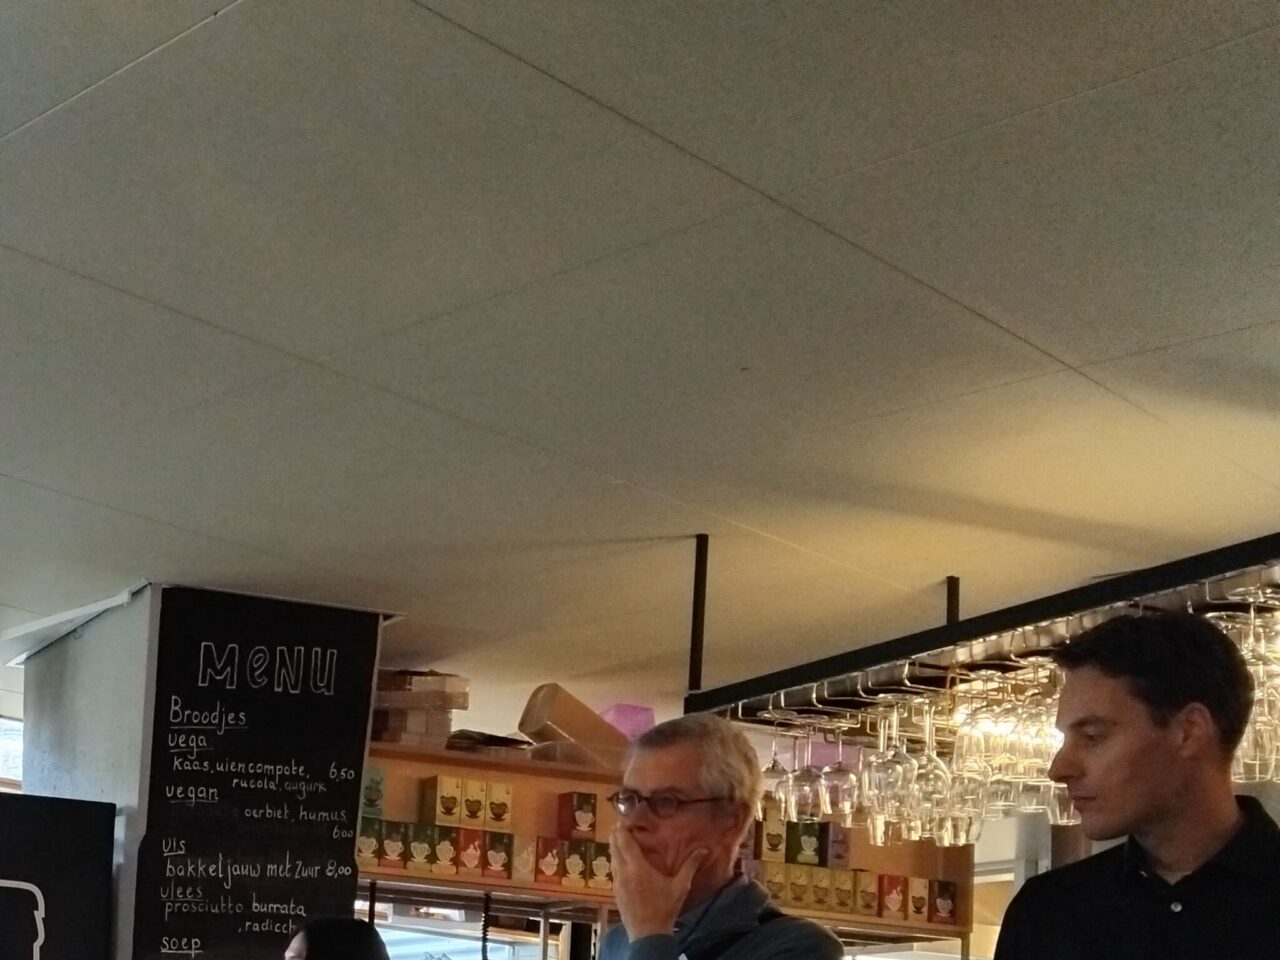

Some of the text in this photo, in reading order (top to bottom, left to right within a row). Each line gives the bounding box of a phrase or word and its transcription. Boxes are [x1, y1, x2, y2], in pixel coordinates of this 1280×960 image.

[170, 695, 246, 735] Broodjes
[329, 761, 355, 782] 6,50
[299, 804, 348, 822] humus
[266, 849, 292, 878] met
[325, 859, 352, 879] 8,00
[165, 892, 307, 922] prosciutto burrata
